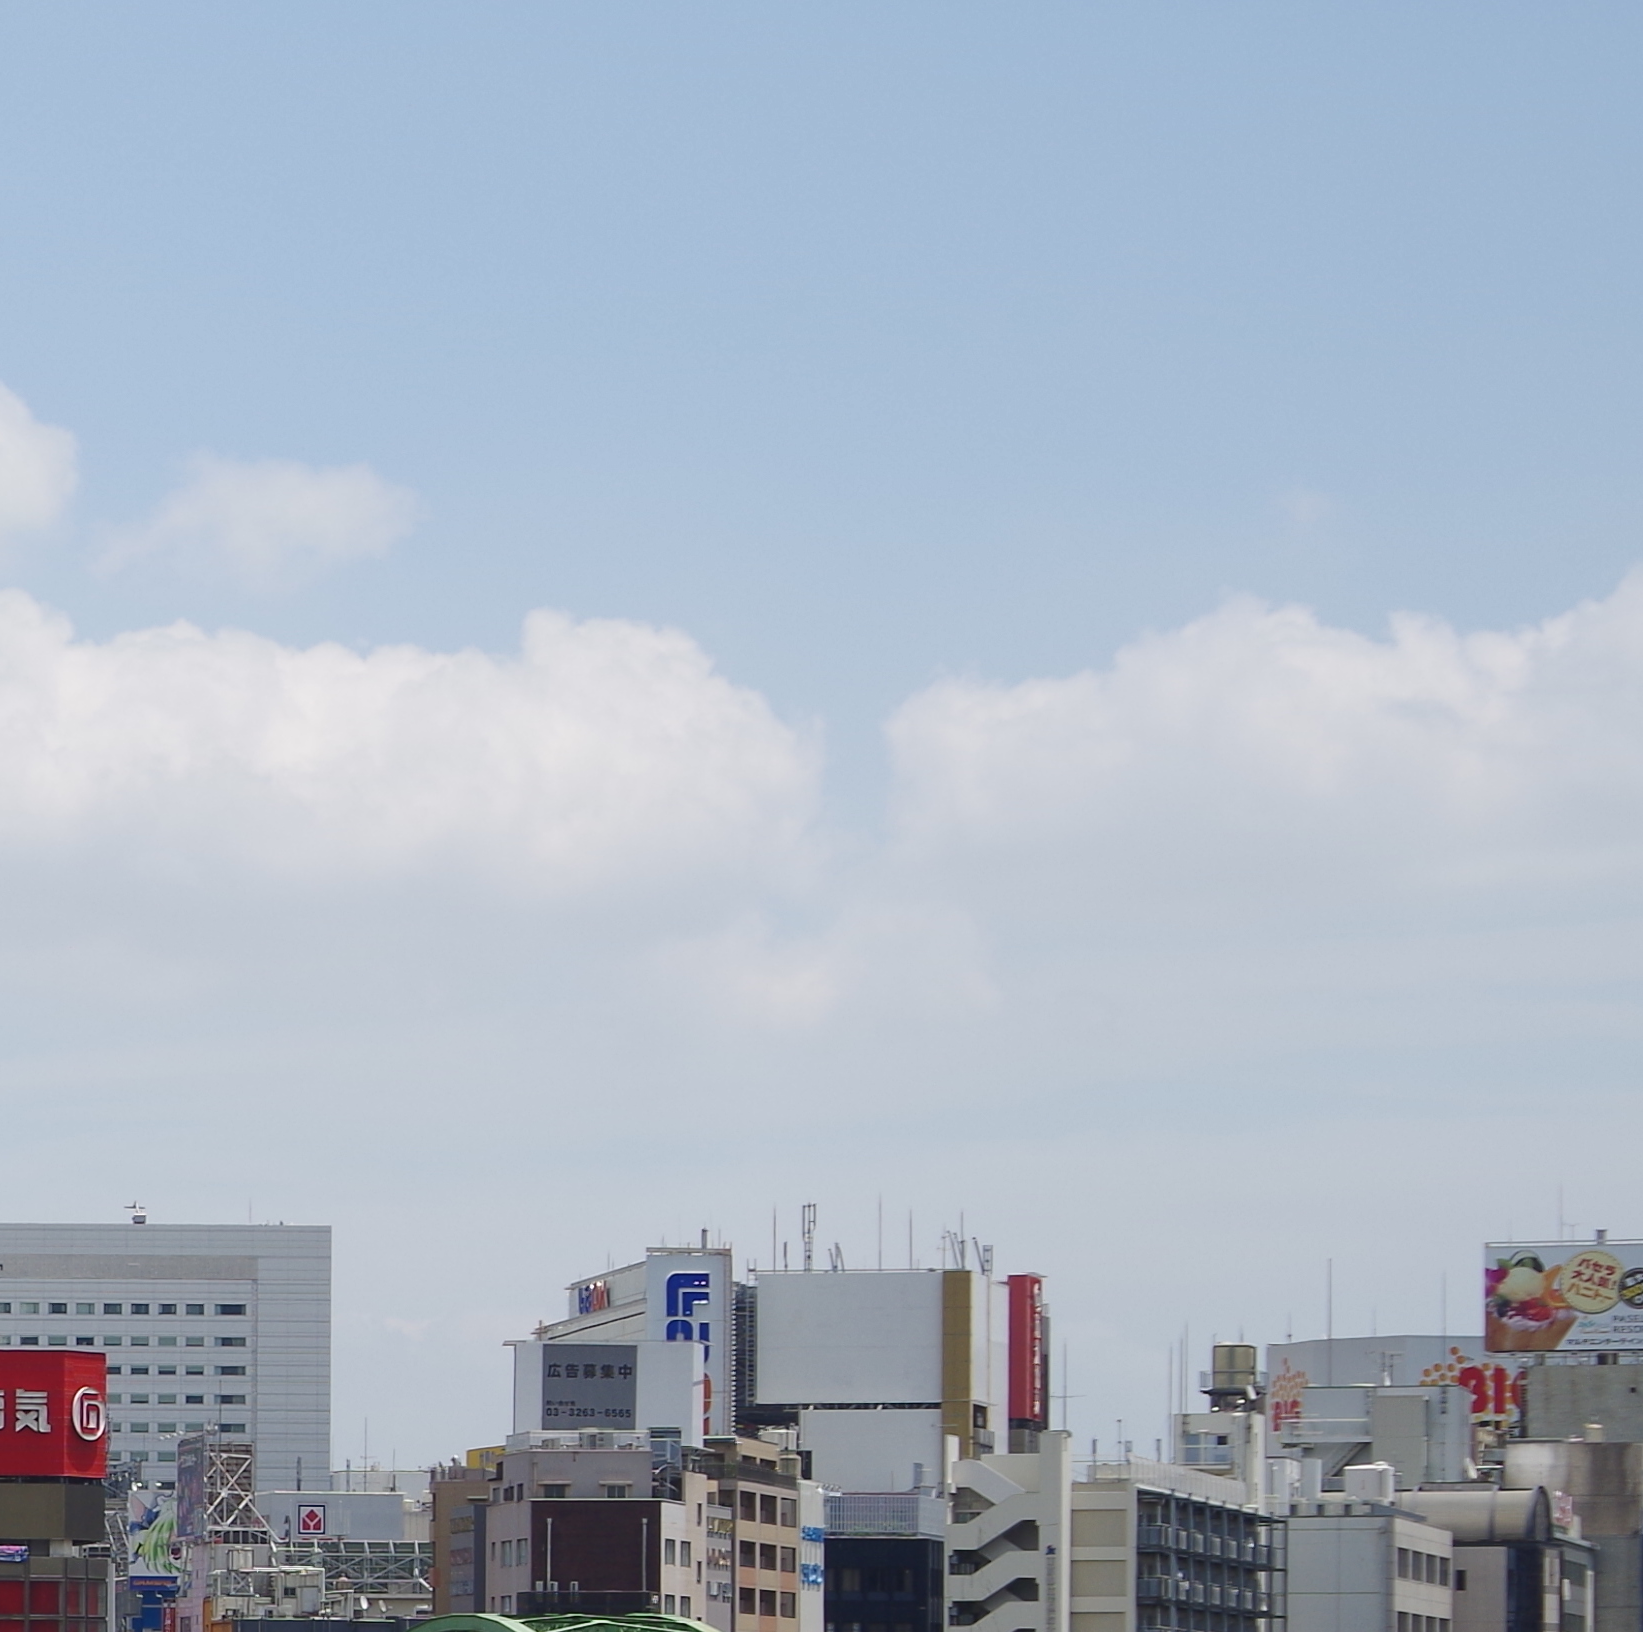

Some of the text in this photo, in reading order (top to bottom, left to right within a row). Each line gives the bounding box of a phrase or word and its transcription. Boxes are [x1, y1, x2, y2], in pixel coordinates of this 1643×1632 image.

[547, 1364, 633, 1380] 広告募集中
[546, 1407, 632, 1418] 03-3263-6565
